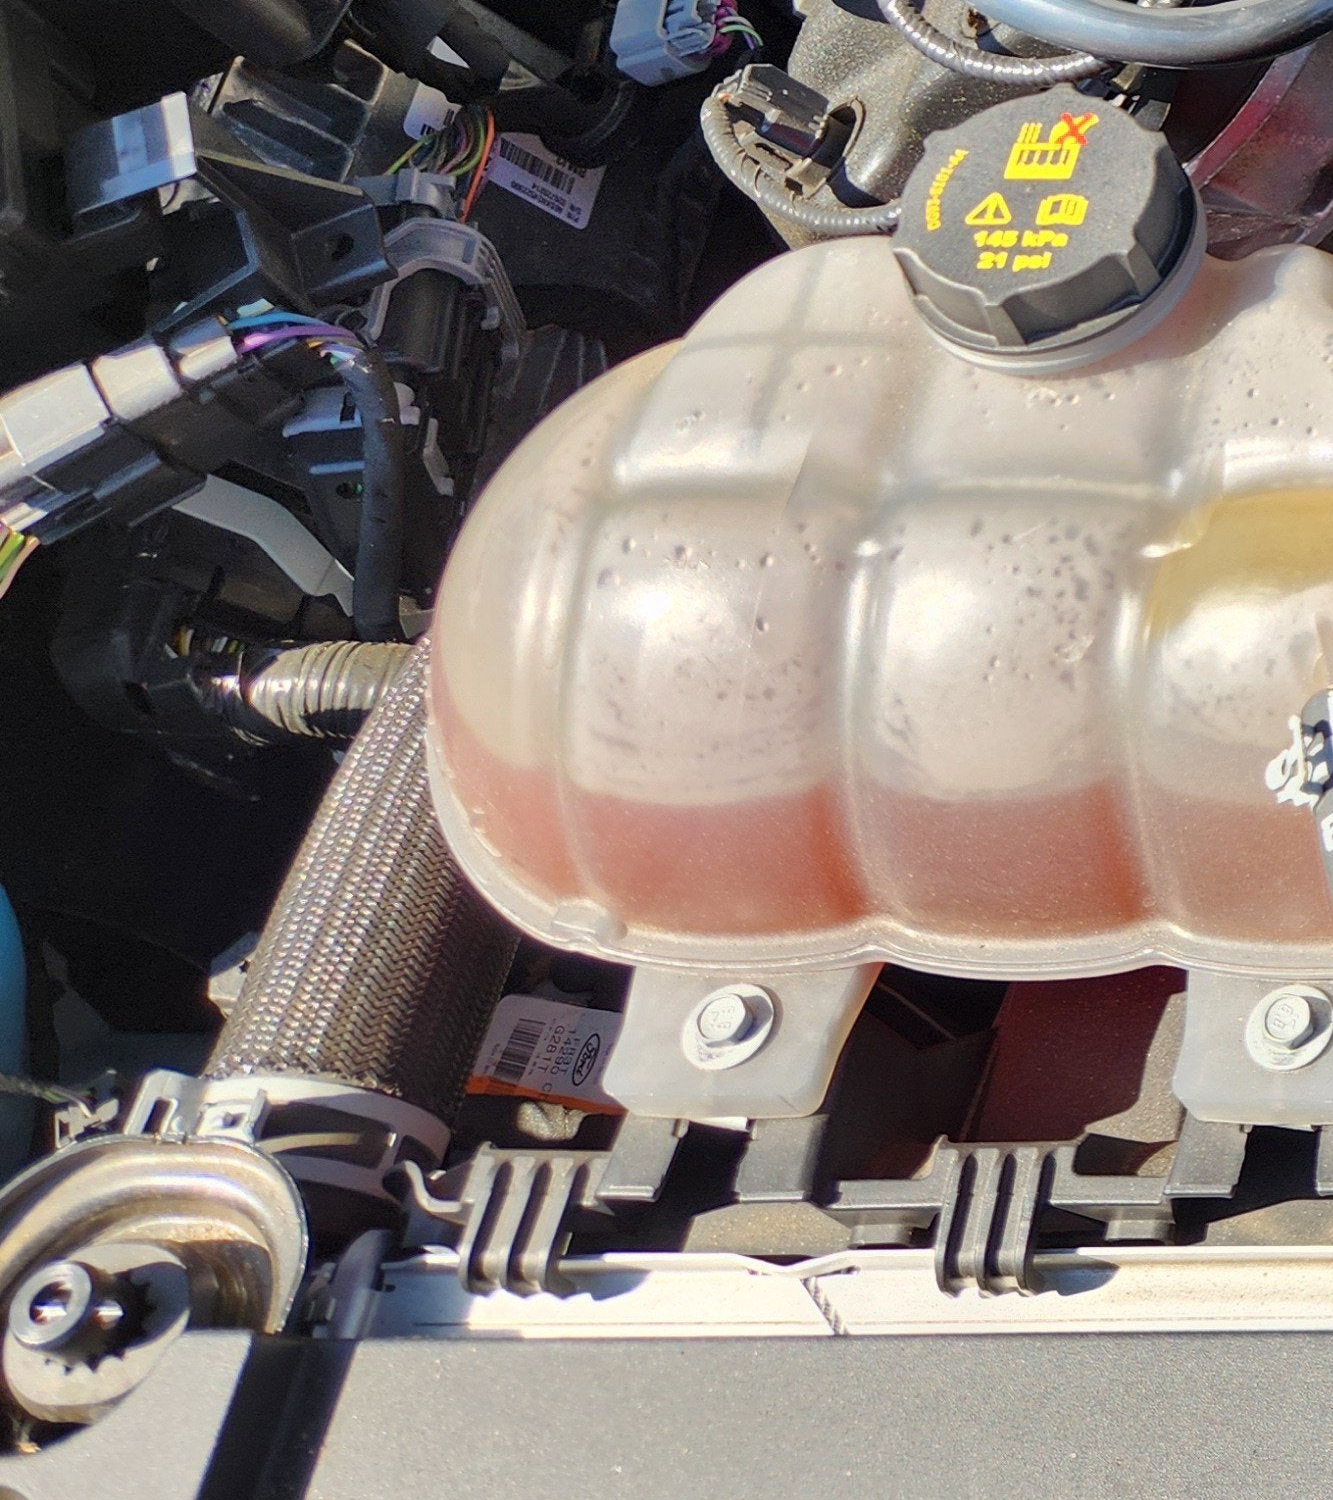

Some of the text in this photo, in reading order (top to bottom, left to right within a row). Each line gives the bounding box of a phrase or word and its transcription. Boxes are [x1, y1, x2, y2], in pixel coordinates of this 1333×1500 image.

[974, 230, 1068, 247] 145 kPa
[976, 252, 1052, 272] 21 psi
[575, 1042, 595, 1078] Ford
